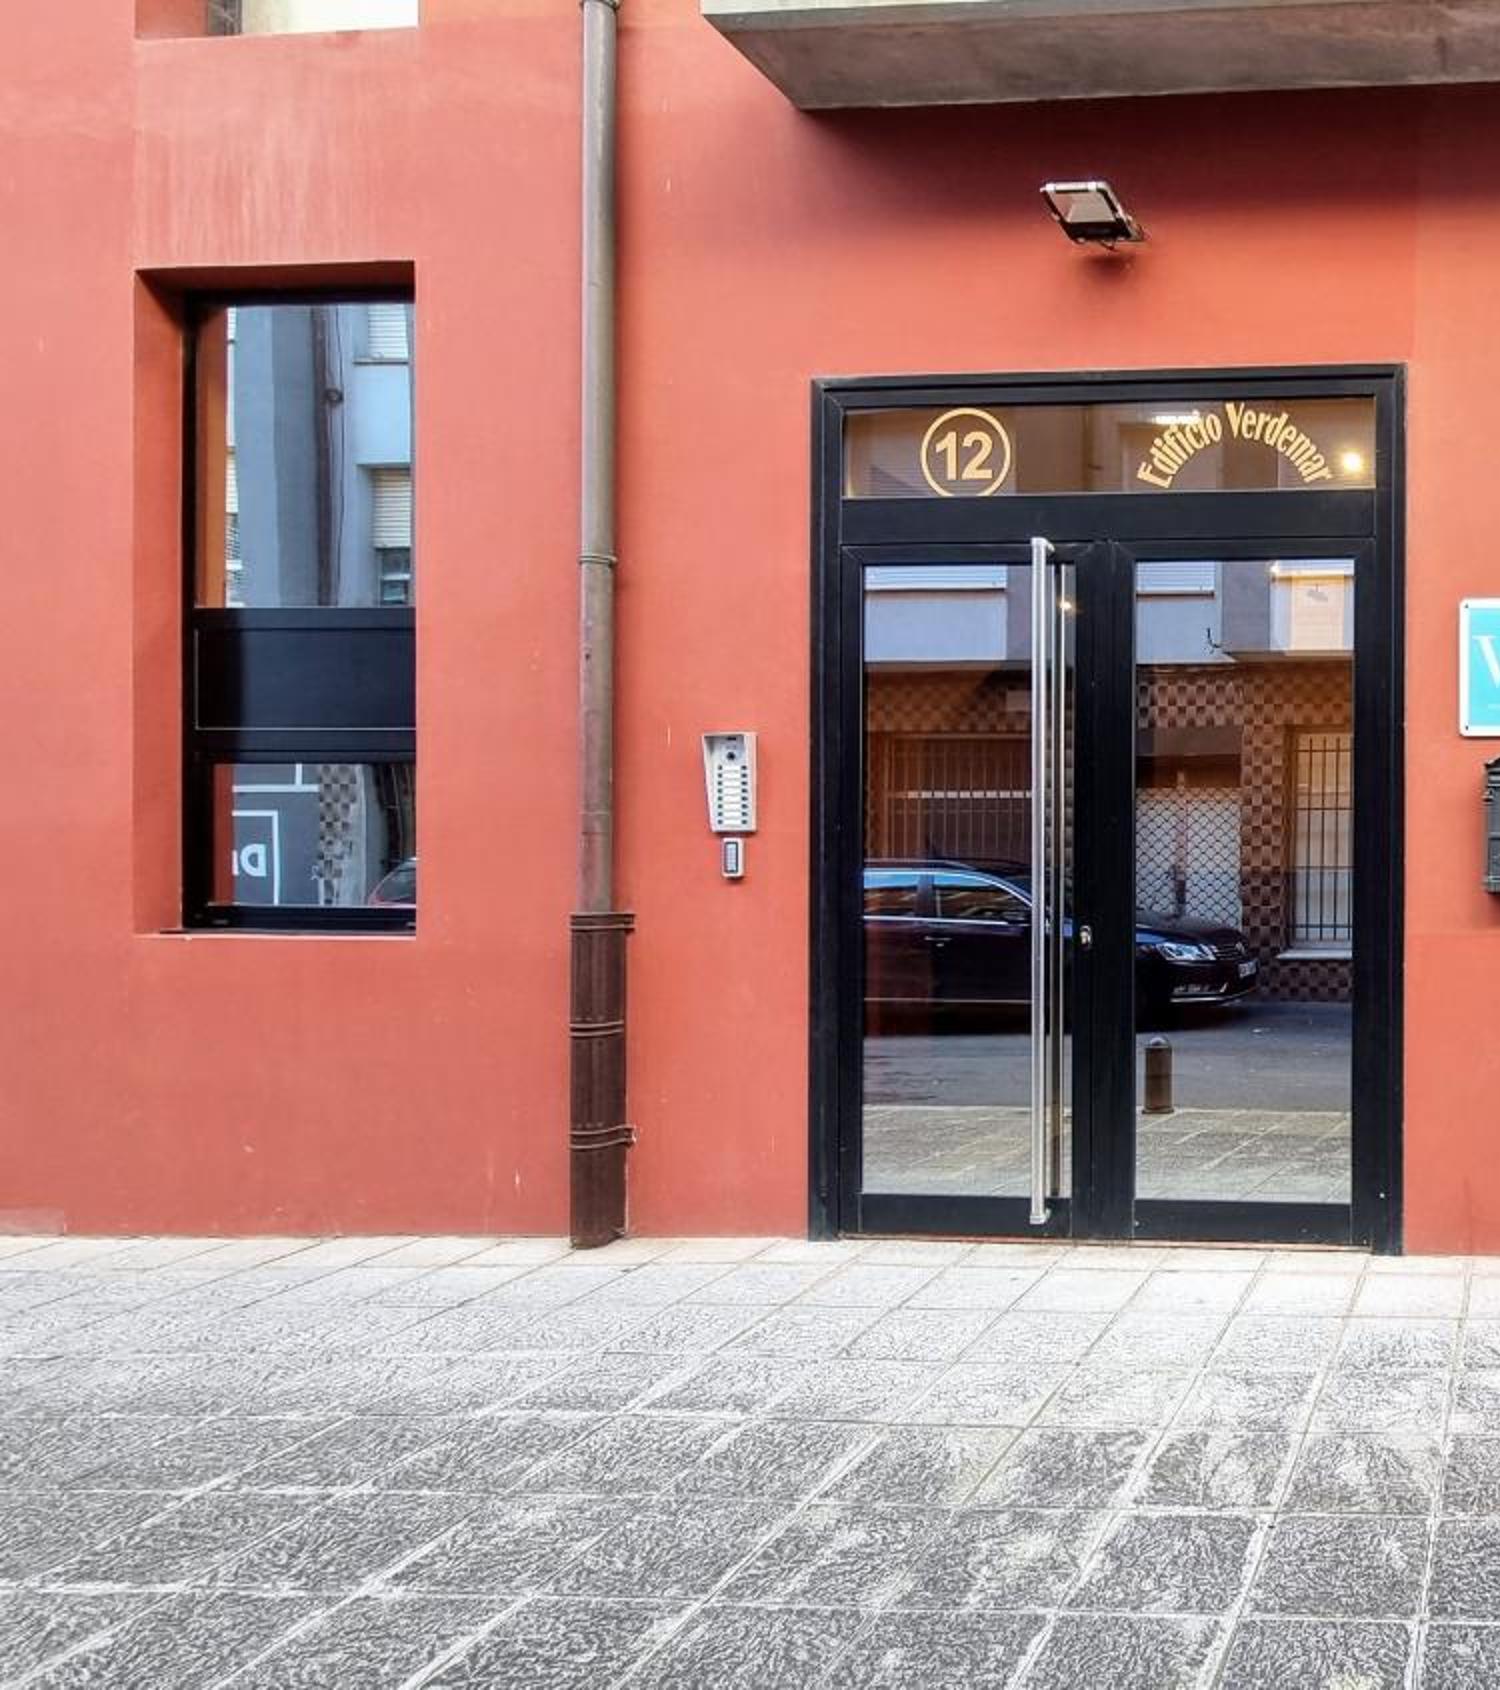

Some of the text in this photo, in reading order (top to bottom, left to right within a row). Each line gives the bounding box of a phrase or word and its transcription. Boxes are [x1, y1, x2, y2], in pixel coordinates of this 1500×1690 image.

[935, 431, 993, 480] 12
[1137, 402, 1332, 489] Edificio Verdemar
